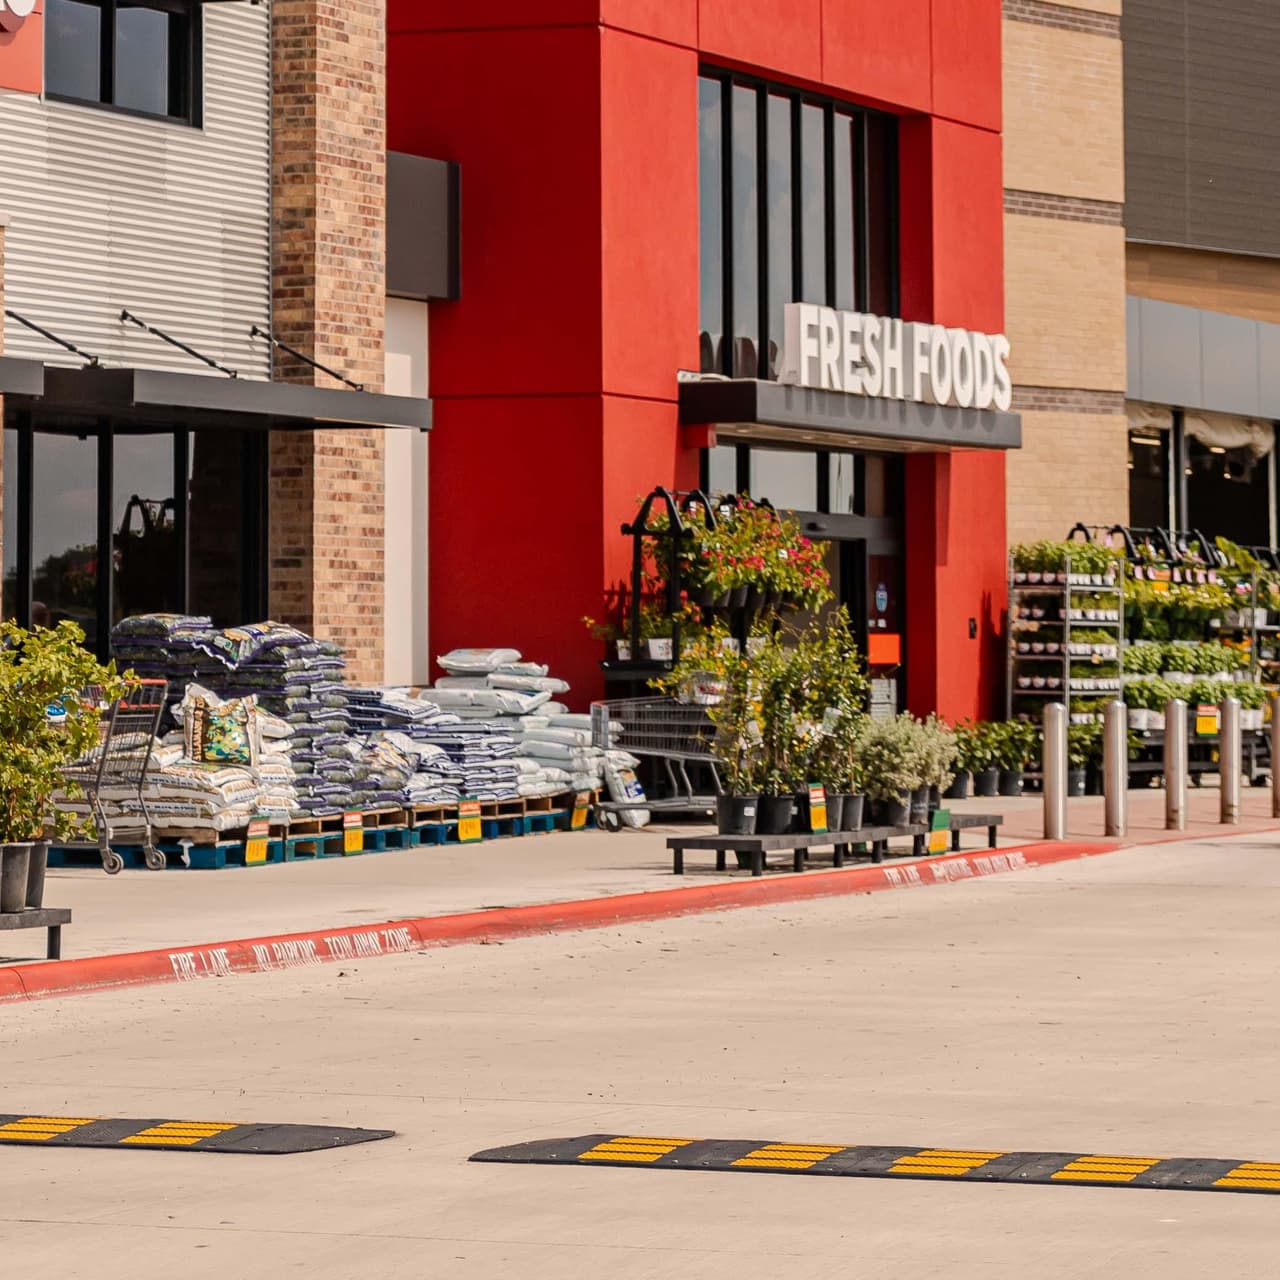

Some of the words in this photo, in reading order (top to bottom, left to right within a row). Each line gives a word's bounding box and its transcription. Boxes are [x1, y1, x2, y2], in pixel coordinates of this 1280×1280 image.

[786, 303, 905, 399] FRESH
[912, 322, 1012, 411] FOODS
[169, 952, 202, 982] FIRE
[199, 948, 236, 978] LANE
[252, 944, 271, 971] NO
[271, 939, 322, 968] PARKING
[381, 927, 415, 951] ZONE
